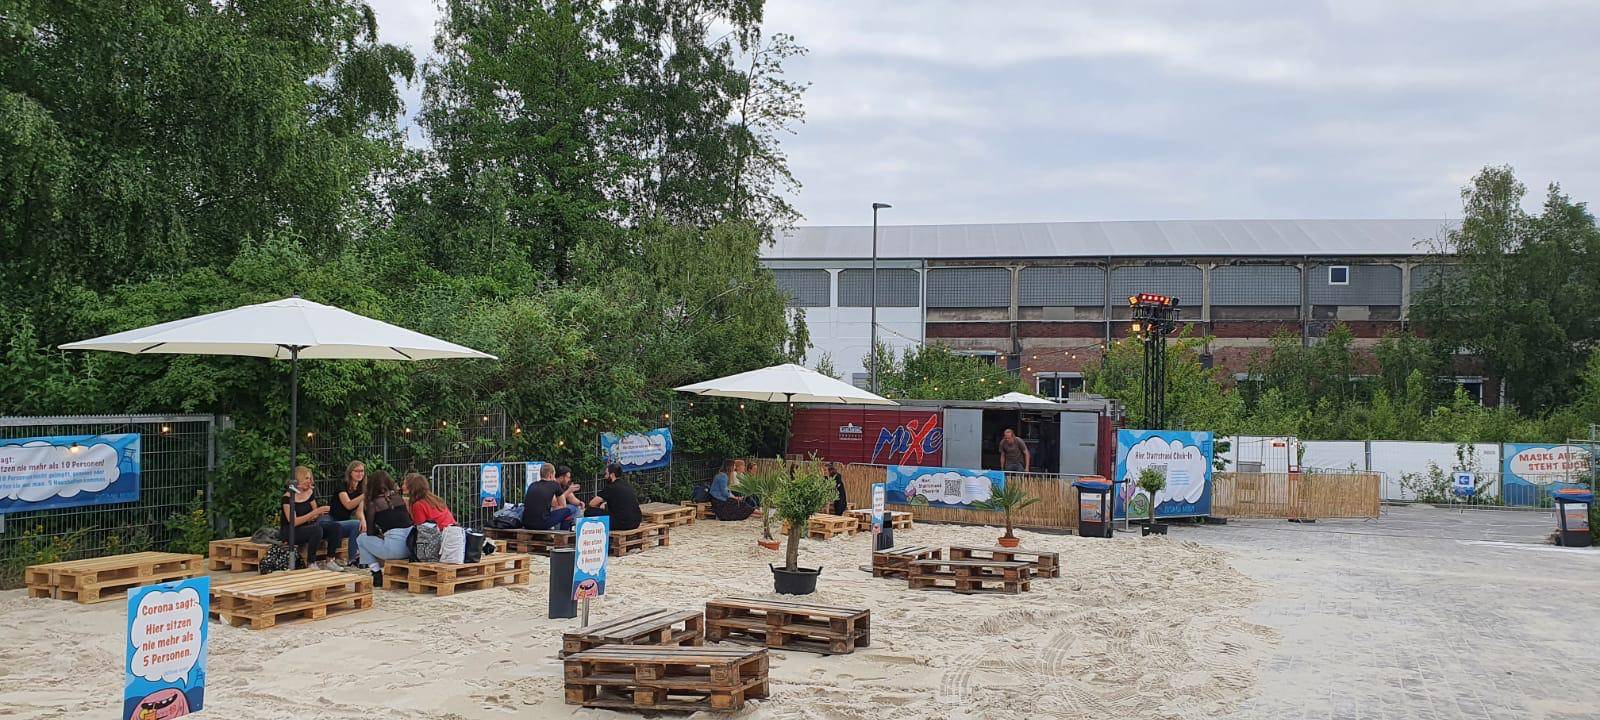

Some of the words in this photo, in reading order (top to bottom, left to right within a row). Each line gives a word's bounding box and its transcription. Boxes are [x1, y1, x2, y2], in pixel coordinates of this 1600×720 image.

[1519, 453, 1554, 462] MASKE
[1557, 451, 1577, 460] AUF
[16, 464, 27, 472] nie
[29, 462, 47, 471] mehr
[48, 462, 59, 470] als
[61, 461, 71, 469] 10
[71, 459, 105, 468] Personen!
[1528, 462, 1558, 470] STEHT
[142, 603, 174, 616] Corona
[175, 598, 196, 610] sagt:
[145, 624, 164, 635] Hier
[166, 618, 192, 632] sitzen
[142, 641, 156, 652] nie
[157, 636, 180, 649] mehr
[181, 632, 194, 643] als
[143, 655, 149, 667] 5
[151, 648, 192, 665] Personen.
